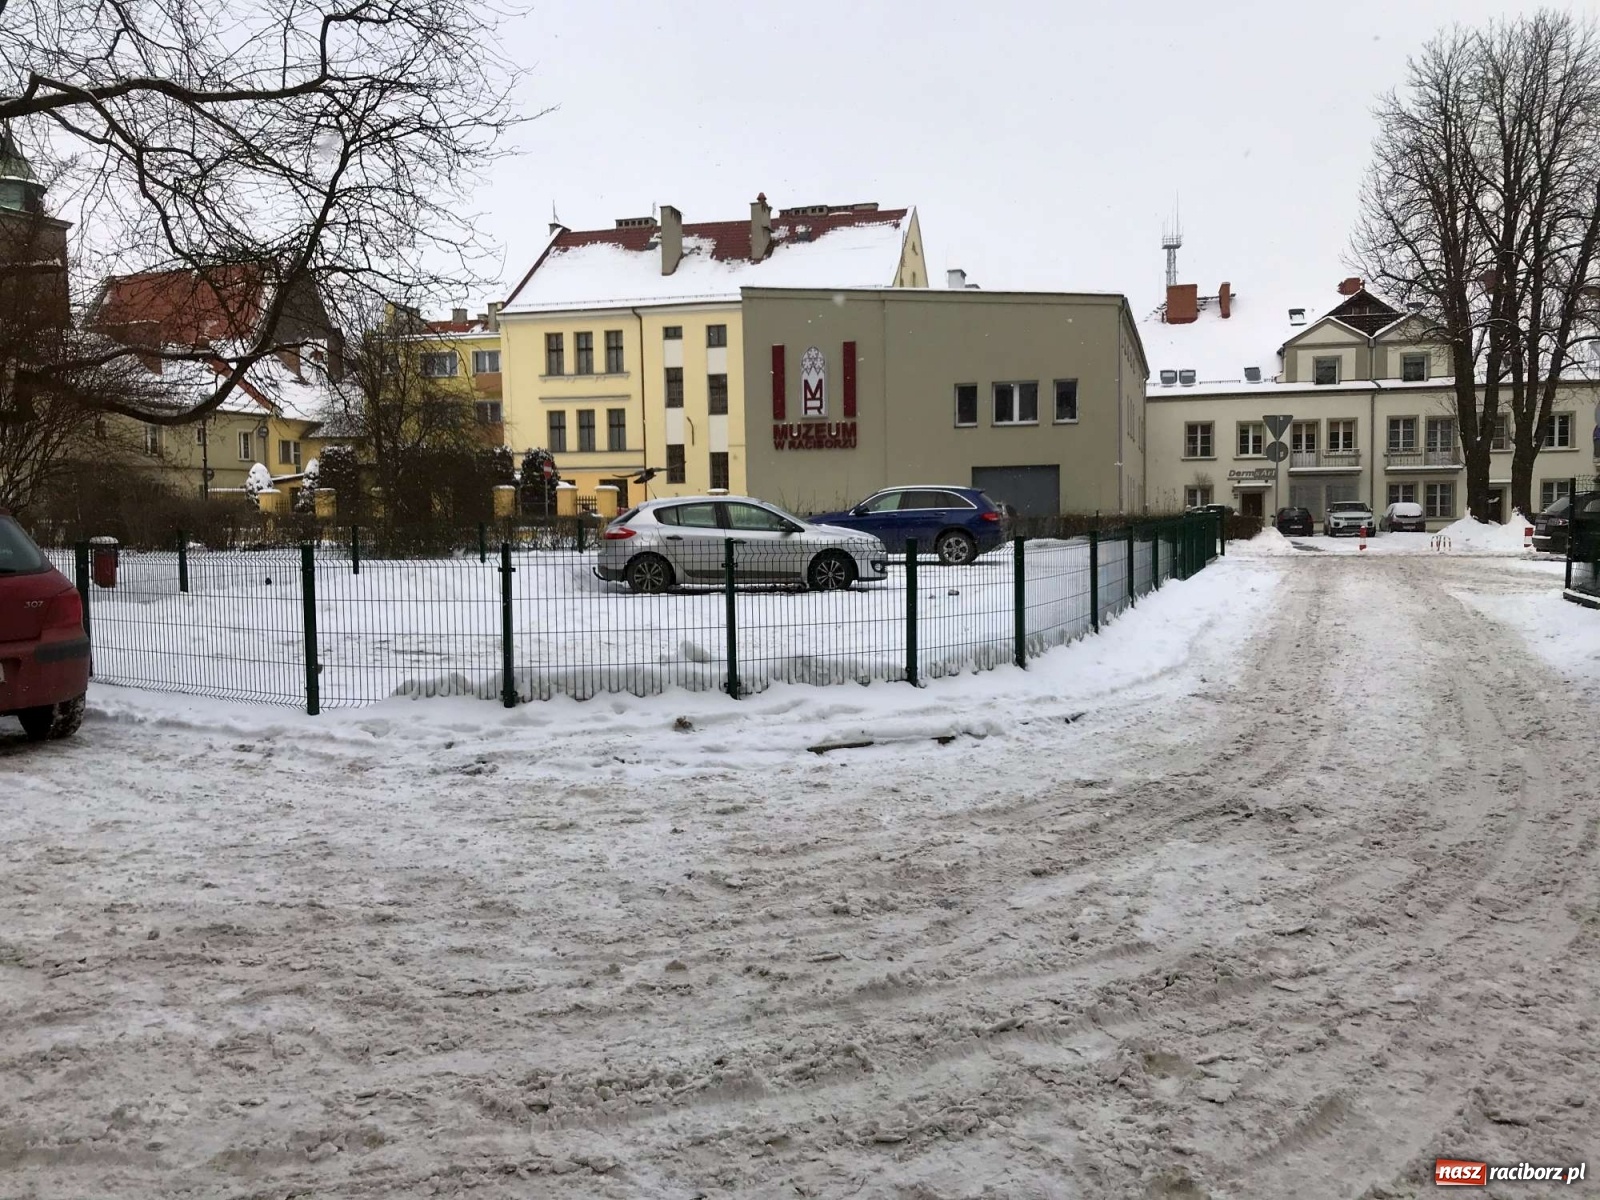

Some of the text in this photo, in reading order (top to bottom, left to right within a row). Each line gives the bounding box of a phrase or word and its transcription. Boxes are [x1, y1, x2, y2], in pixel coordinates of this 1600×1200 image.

[773, 421, 857, 440] MUZEUM
[773, 439, 857, 450] W RACIBORZU
[24, 600, 44, 609] 307
